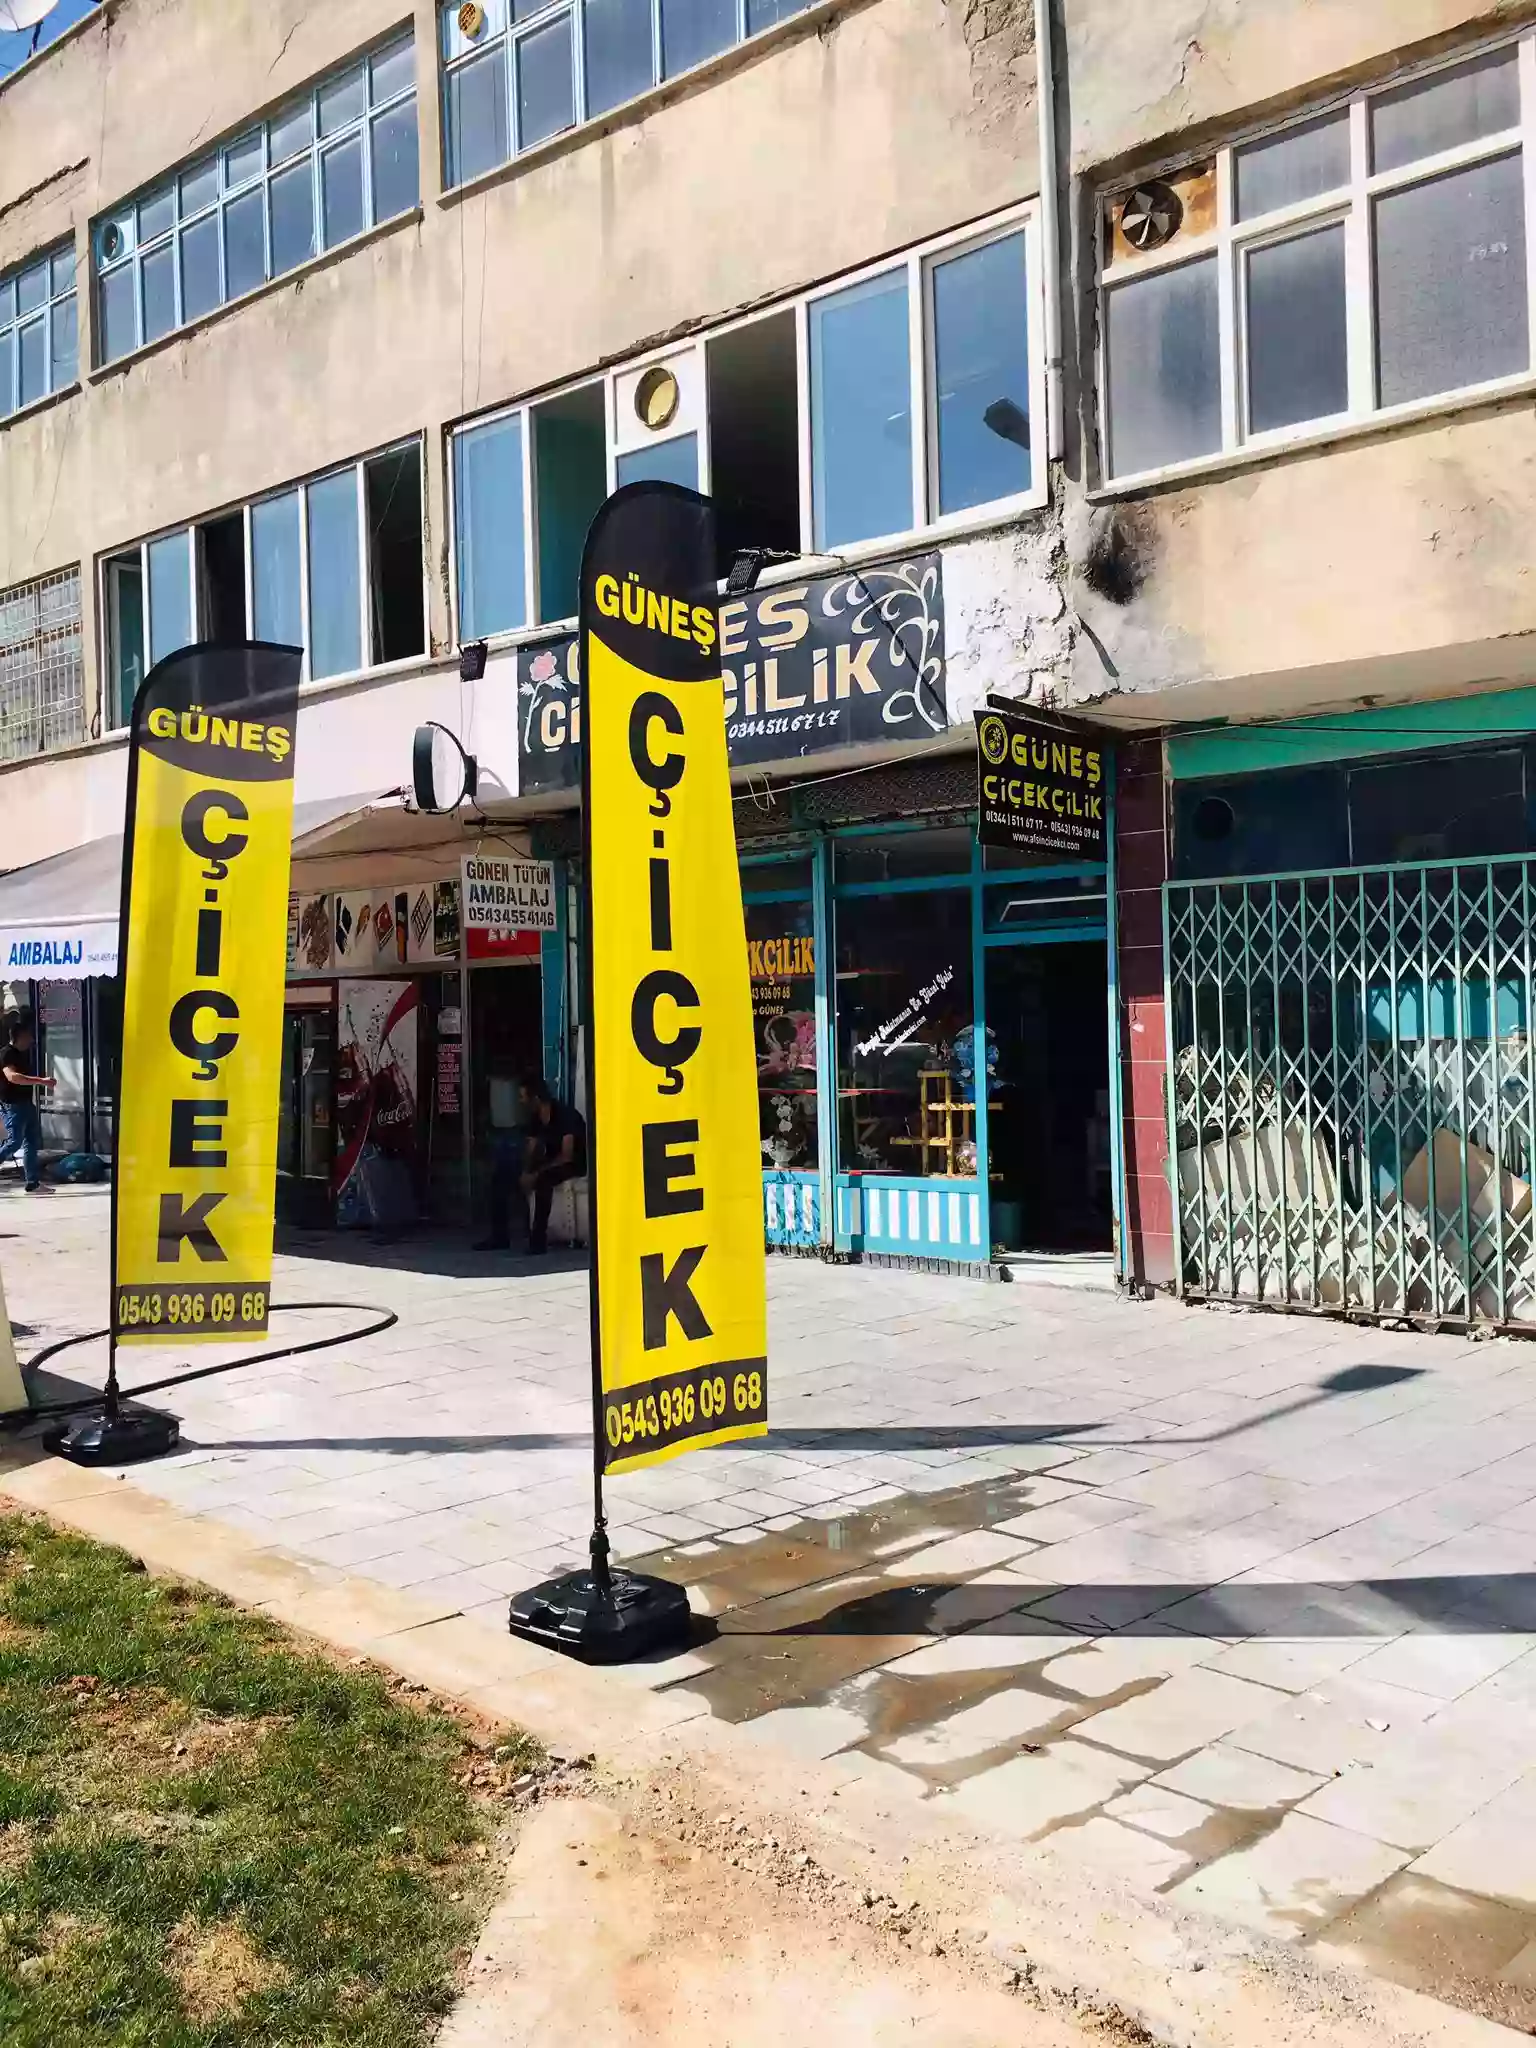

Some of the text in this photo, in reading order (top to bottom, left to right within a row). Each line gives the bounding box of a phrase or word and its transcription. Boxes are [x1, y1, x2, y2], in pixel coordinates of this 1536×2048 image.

[595, 572, 716, 656] GÜNEŞ
[148, 704, 291, 763] GÜNEŞ
[1011, 733, 1101, 788] GÜNEŞ
[983, 775, 1102, 820] ÇİÇEKÇİLİK
[1011, 815, 1024, 827] 511
[1025, 817, 1034, 829] 67
[1071, 825, 1083, 837] 936
[1083, 828, 1091, 838] 09
[1092, 829, 1100, 840] 68
[466, 859, 551, 884] GÖNEN TÜTÜN
[469, 884, 549, 907] AMBALAJ
[8, 940, 83, 966] AMBALAJ
[746, 937, 816, 986] KÇİLİK
[759, 1004, 784, 1016] GÜNEŞ
[760, 986, 772, 1000] 936
[773, 986, 781, 999] 09
[156, 788, 249, 1263] ÇİÇEK
[628, 691, 714, 1352] ÇİÇEK
[119, 1292, 265, 1325] 0543 936 09 68
[606, 1371, 762, 1447] 0543 936 09 68
